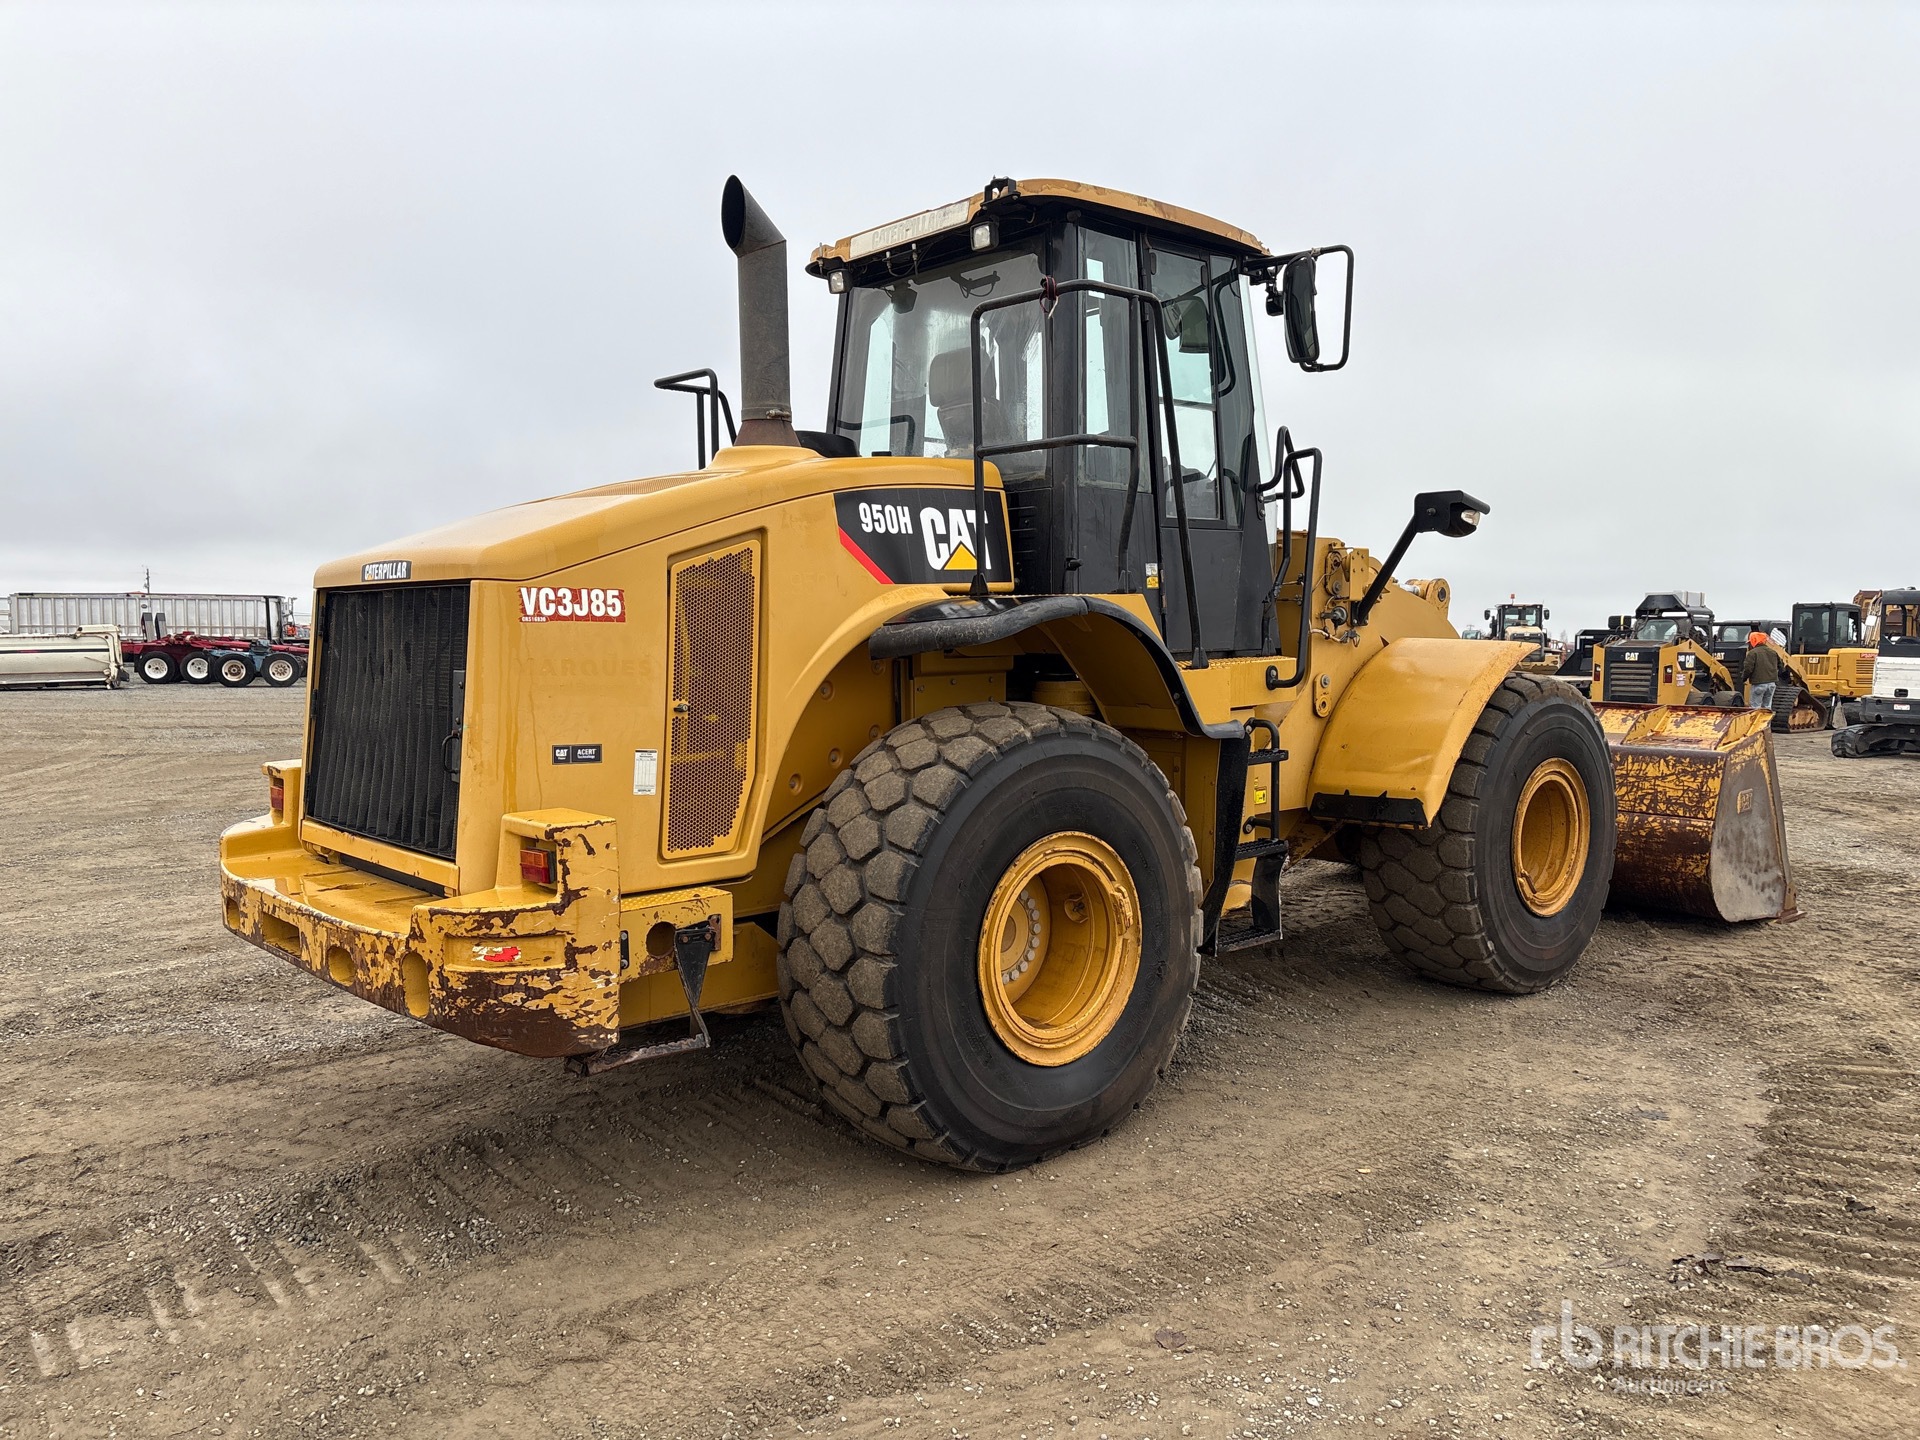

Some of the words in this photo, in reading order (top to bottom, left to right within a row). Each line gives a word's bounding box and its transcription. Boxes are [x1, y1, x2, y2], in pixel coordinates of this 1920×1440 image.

[858, 502, 914, 534] 950H
[919, 506, 992, 571] CAT
[364, 561, 407, 580] CATERPILLAR
[520, 586, 623, 617] VC3J85
[1624, 652, 1640, 661] CAT
[555, 748, 569, 757] CAT
